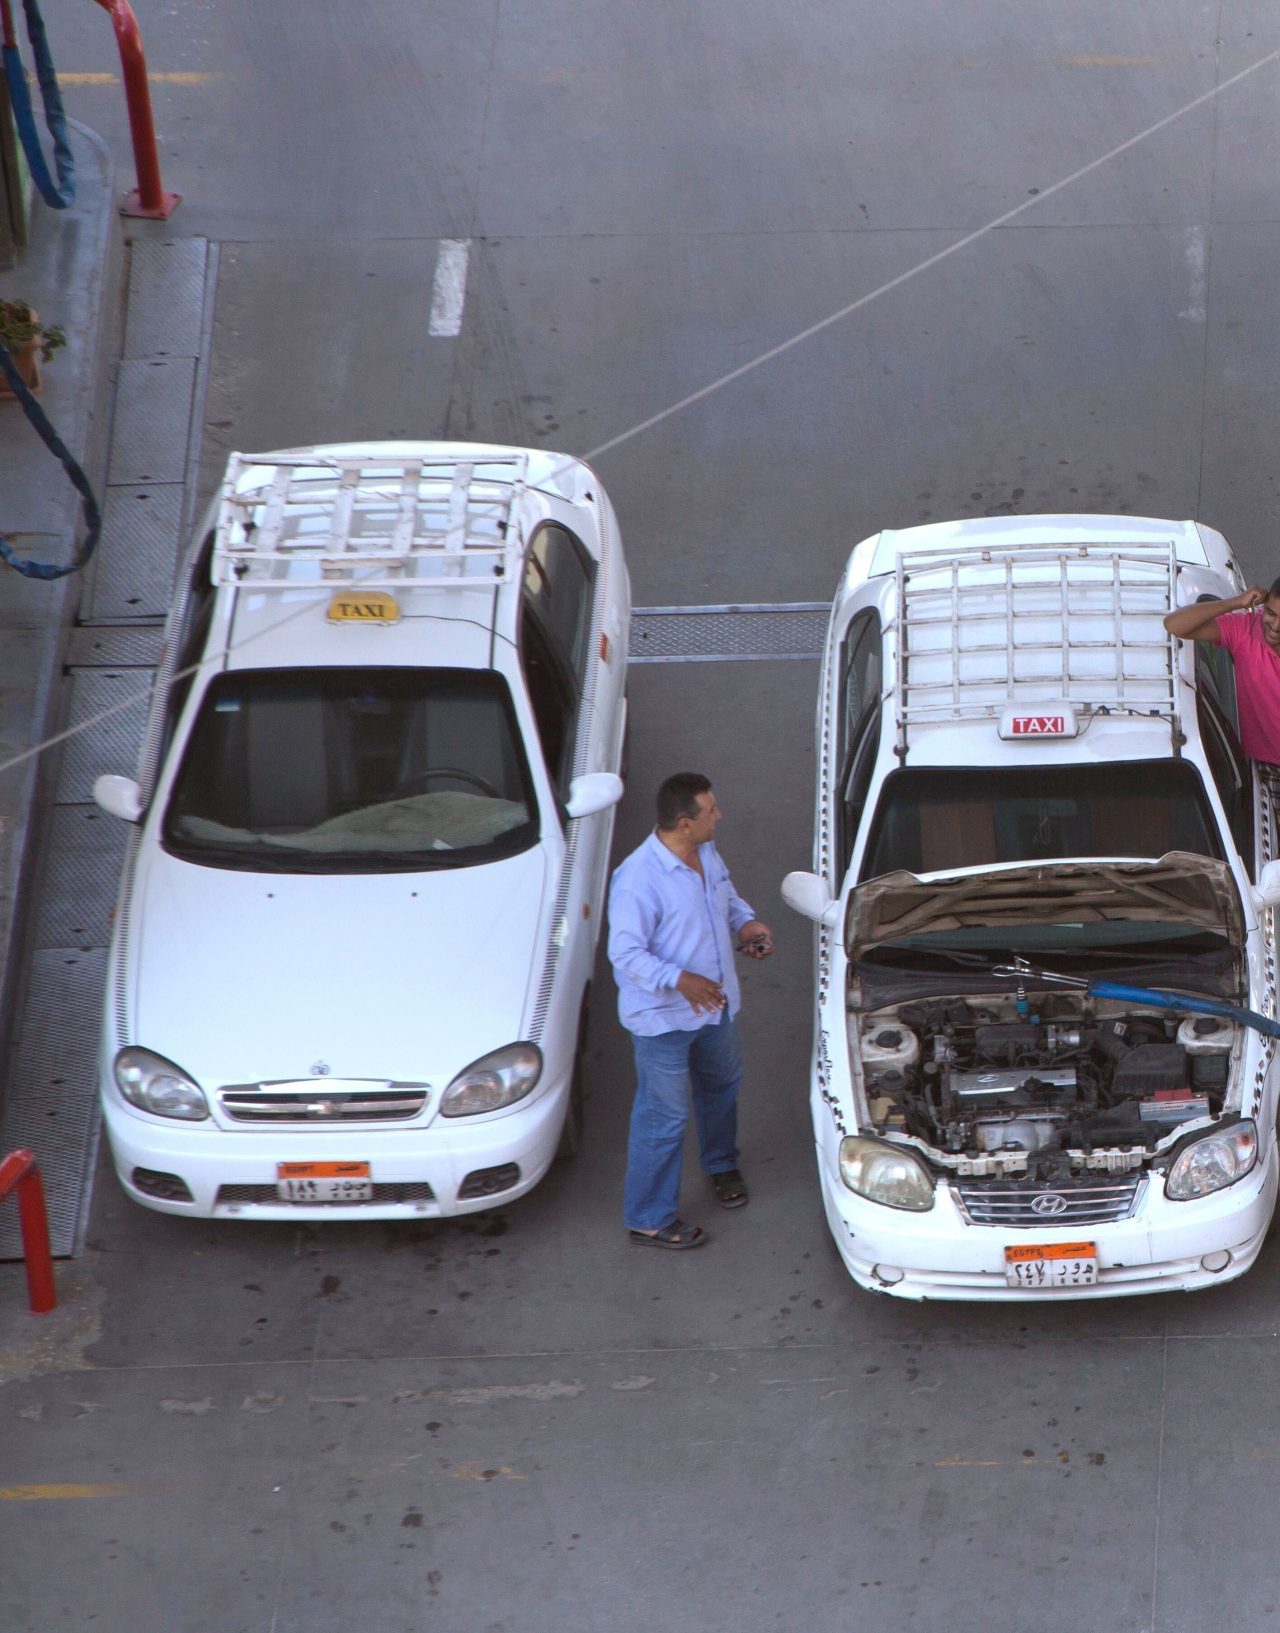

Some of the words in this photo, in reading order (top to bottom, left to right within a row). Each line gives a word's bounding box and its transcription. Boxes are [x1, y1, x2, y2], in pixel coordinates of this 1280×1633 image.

[338, 603, 385, 617] TAXI
[1015, 718, 1062, 733] TAXI
[1013, 1248, 1042, 1258] EGYPT
[1062, 1246, 1088, 1255] مصر
